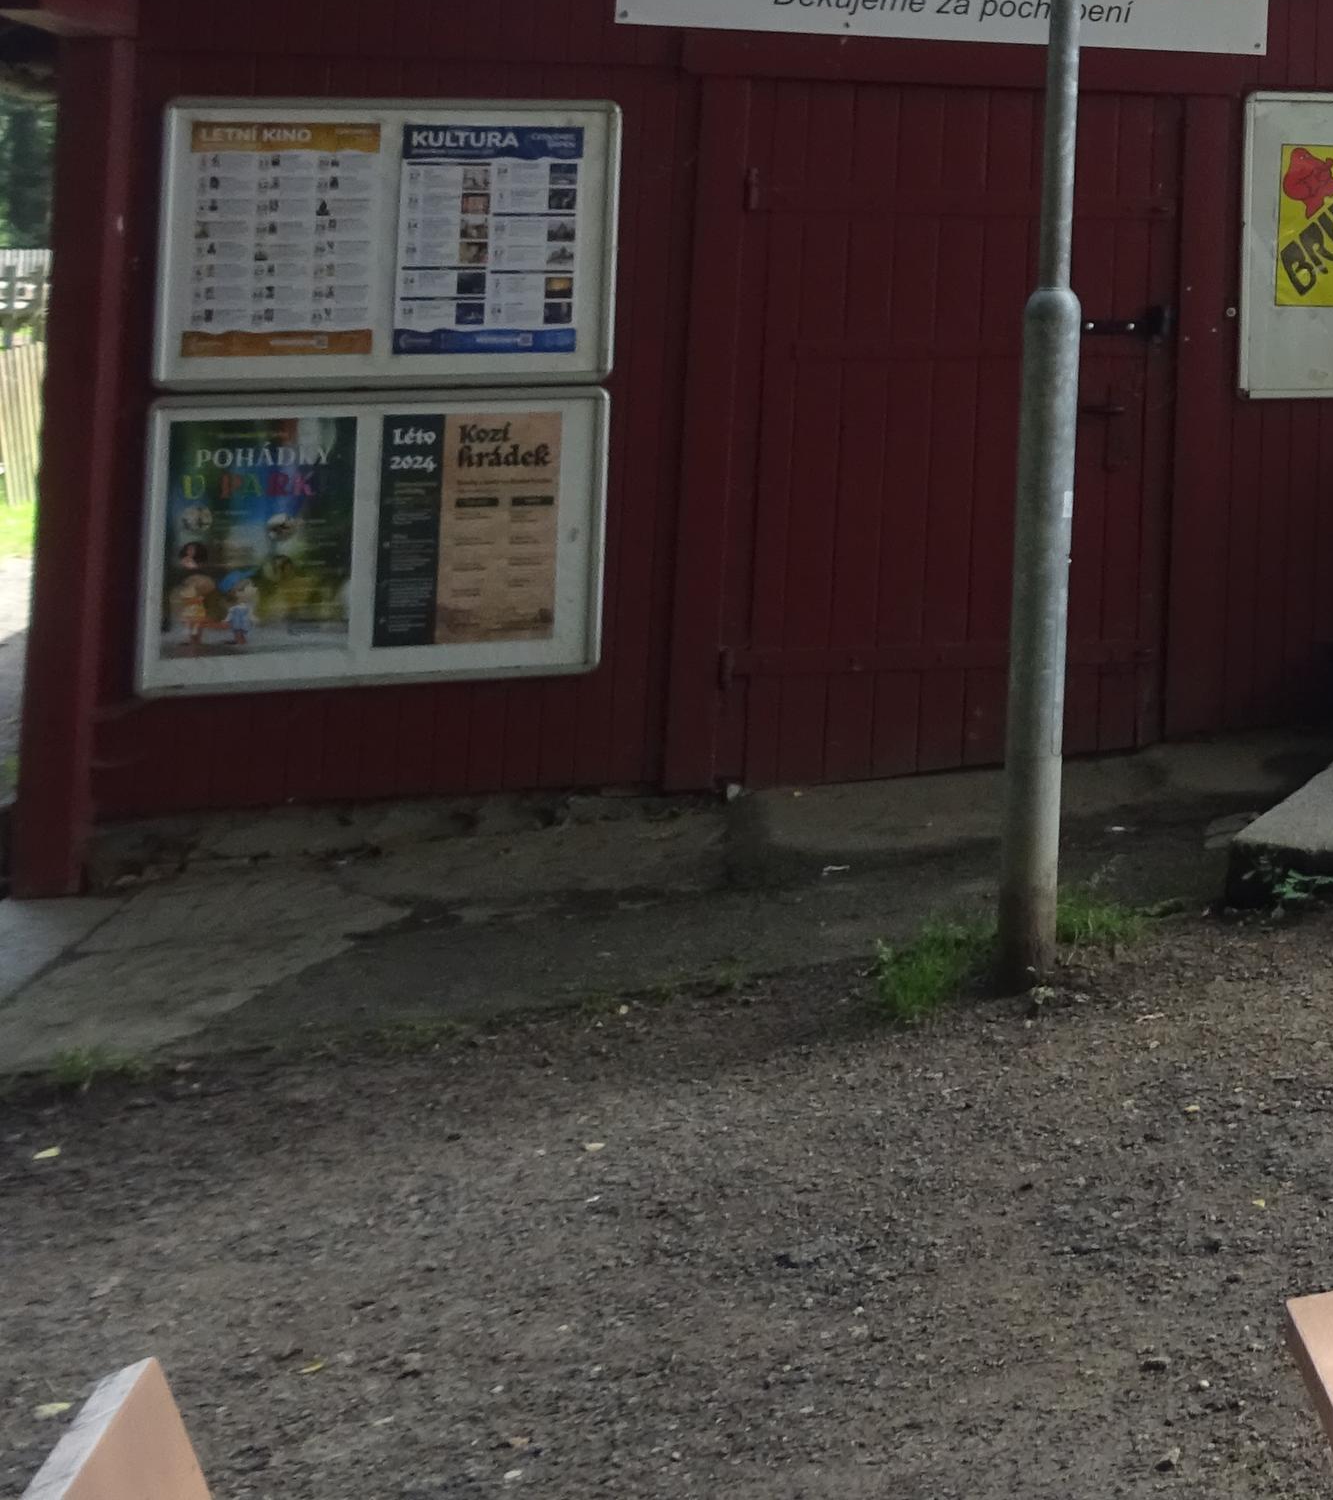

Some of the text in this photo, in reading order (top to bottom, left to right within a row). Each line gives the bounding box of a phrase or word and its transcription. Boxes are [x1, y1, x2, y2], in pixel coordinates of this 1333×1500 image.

[201, 123, 257, 143] LETNÍ
[262, 126, 314, 143] KINO
[411, 130, 520, 149] KULTURA
[393, 426, 438, 446] Léto
[457, 421, 512, 445] Kozí
[195, 441, 334, 469] POHÁDKY
[389, 454, 438, 474] 2024
[456, 443, 552, 469] hrádek
